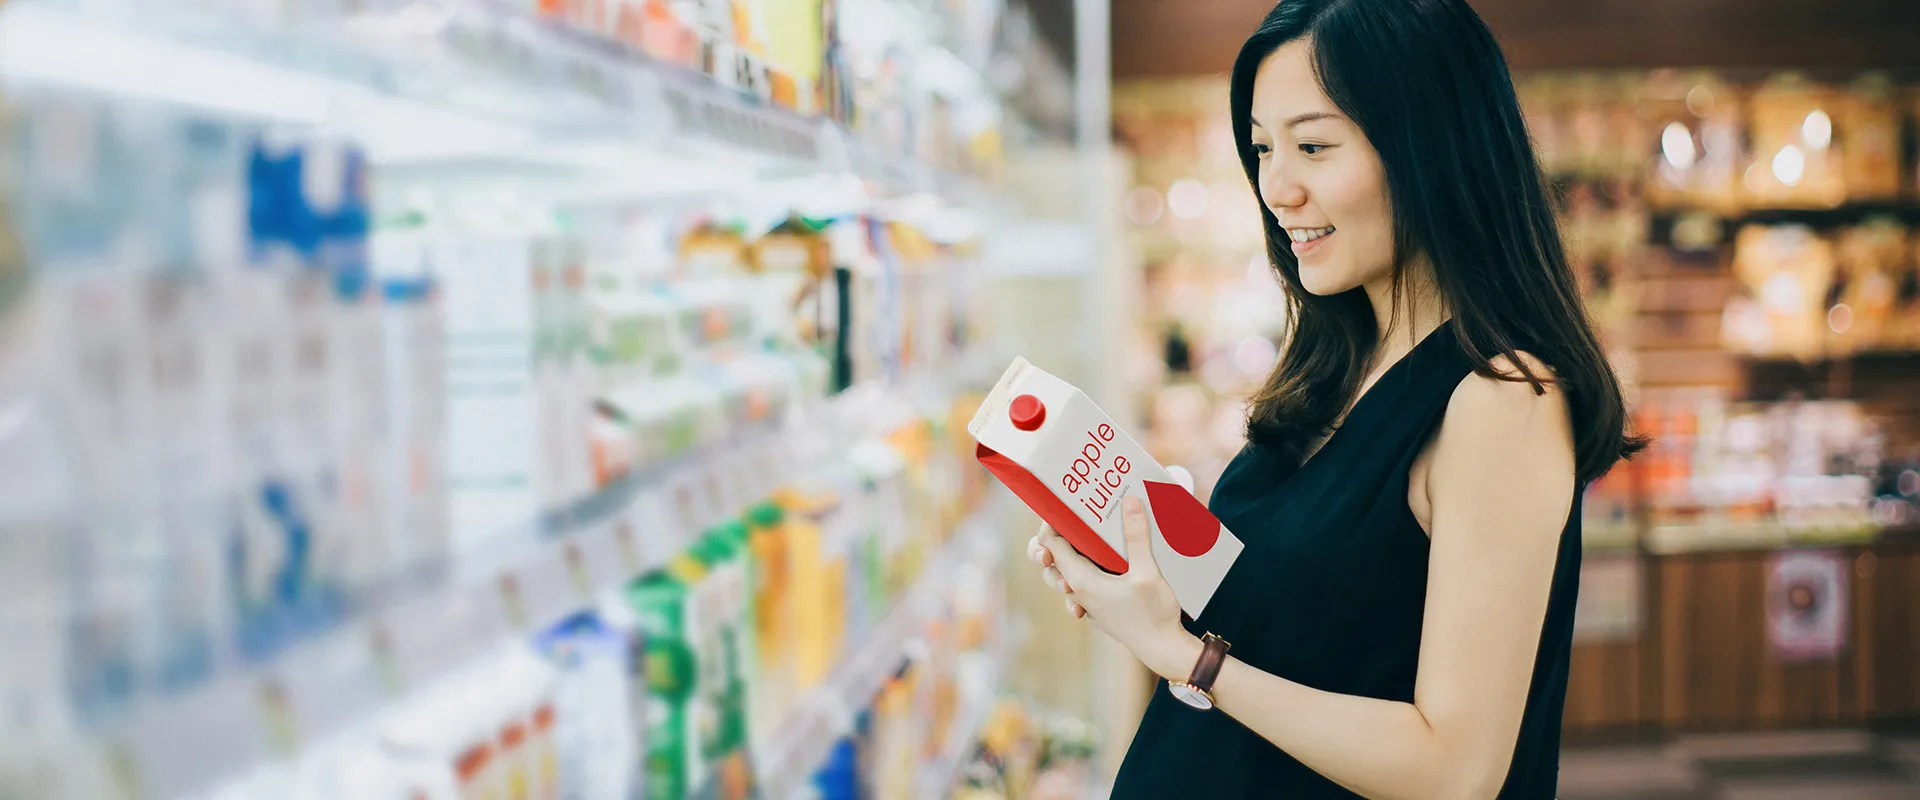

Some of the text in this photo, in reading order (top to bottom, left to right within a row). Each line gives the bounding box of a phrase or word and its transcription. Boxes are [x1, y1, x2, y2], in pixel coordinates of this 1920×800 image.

[1062, 423, 1115, 494] apple
[1080, 456, 1131, 524] juice
[1105, 484, 1131, 520] premium quality
